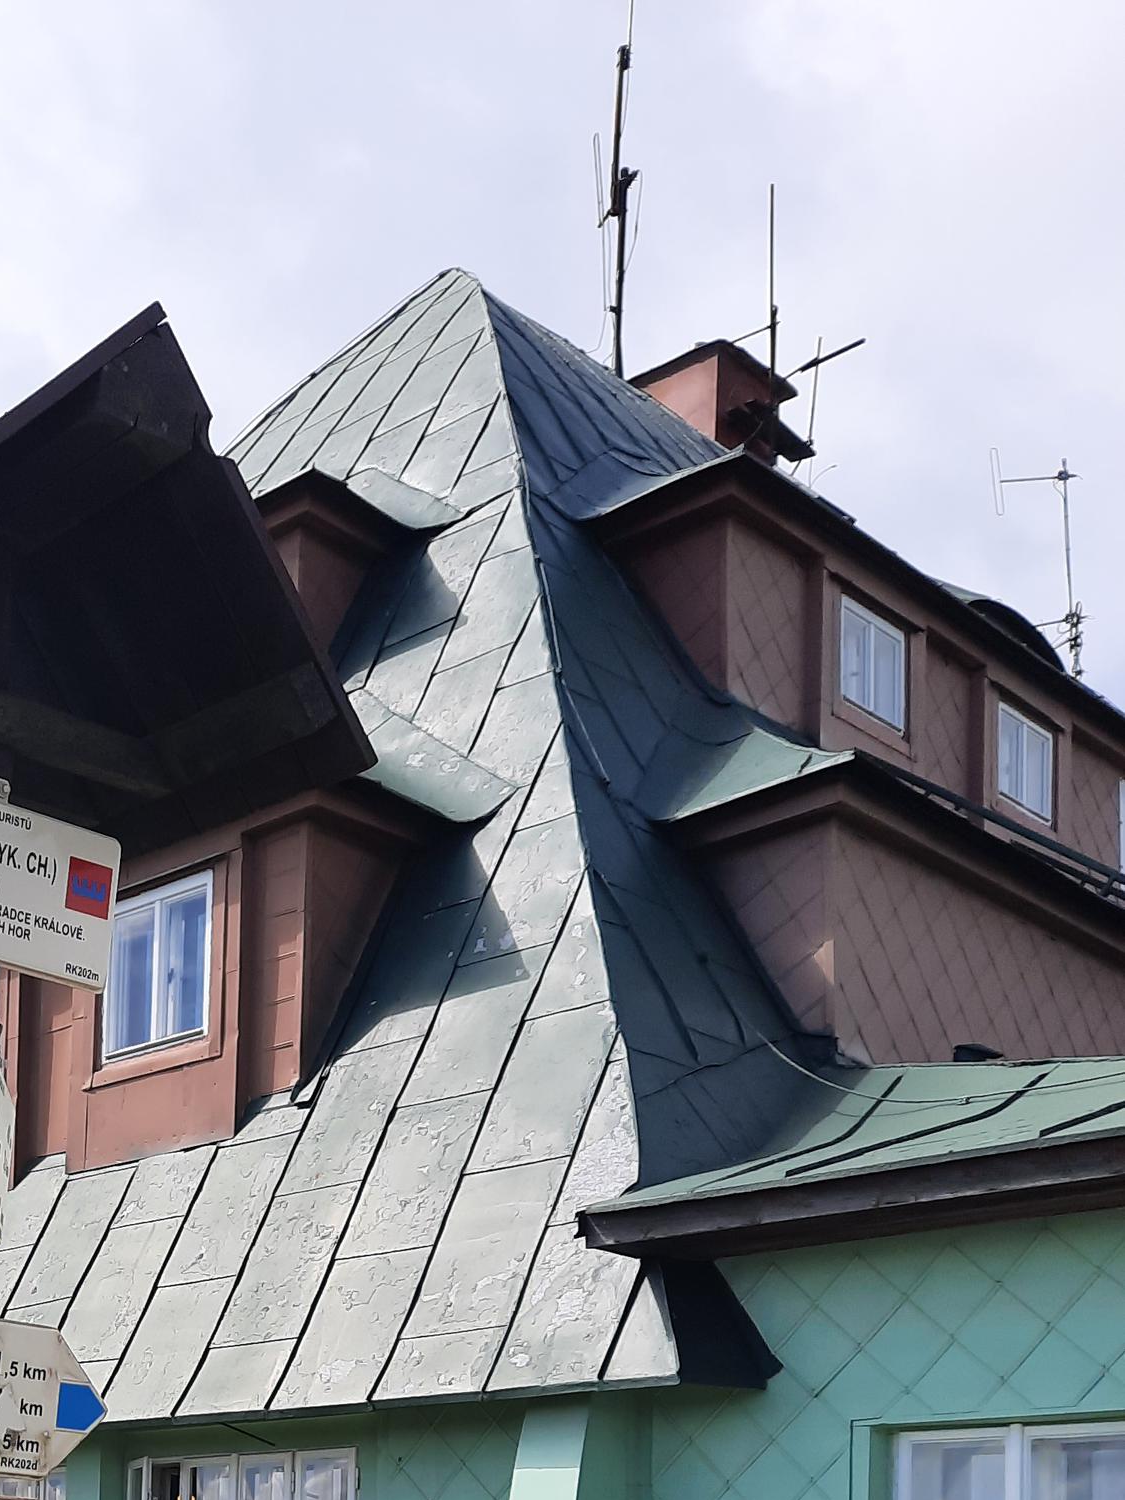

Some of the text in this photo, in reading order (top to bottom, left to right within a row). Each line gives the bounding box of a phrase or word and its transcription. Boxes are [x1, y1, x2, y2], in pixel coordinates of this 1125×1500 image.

[26, 852, 56, 884] CH.)
[7, 923, 31, 940] HOR
[34, 916, 85, 940] KRÁLOVÉ.
[65, 963, 99, 981] RK202m
[23, 1366, 46, 1381] km
[20, 1400, 43, 1416] km
[16, 1437, 39, 1453] km
[0, 1457, 38, 1470] RK202d
